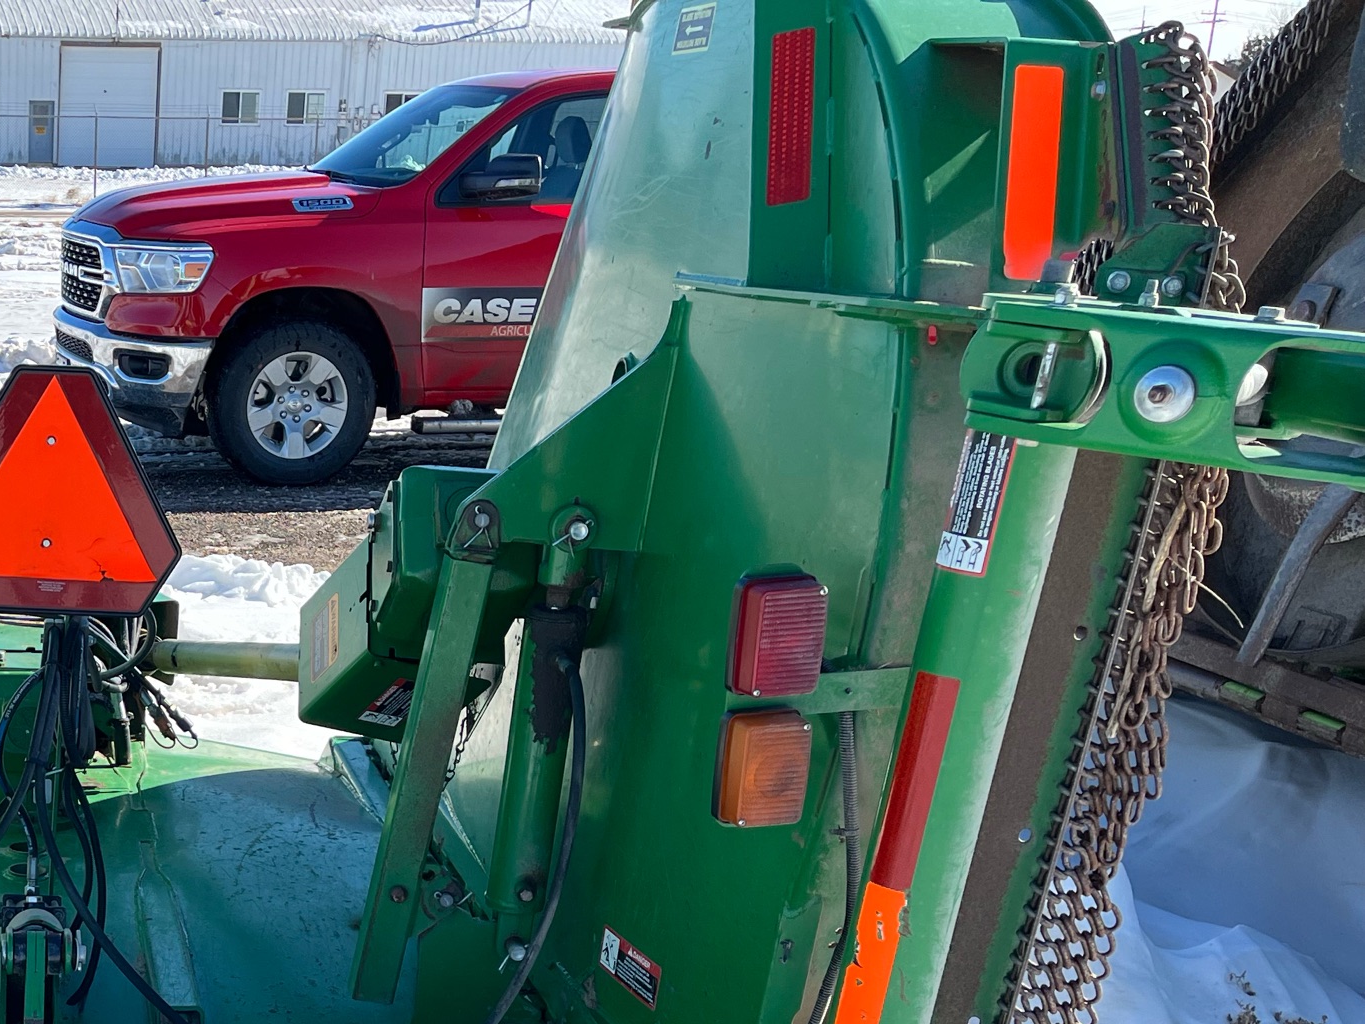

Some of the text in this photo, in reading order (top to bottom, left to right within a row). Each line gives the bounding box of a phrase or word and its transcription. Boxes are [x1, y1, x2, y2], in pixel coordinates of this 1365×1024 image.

[300, 198, 344, 207] 1500
[433, 298, 537, 323] CASE
[976, 445, 996, 508] ROTATING BLADES
